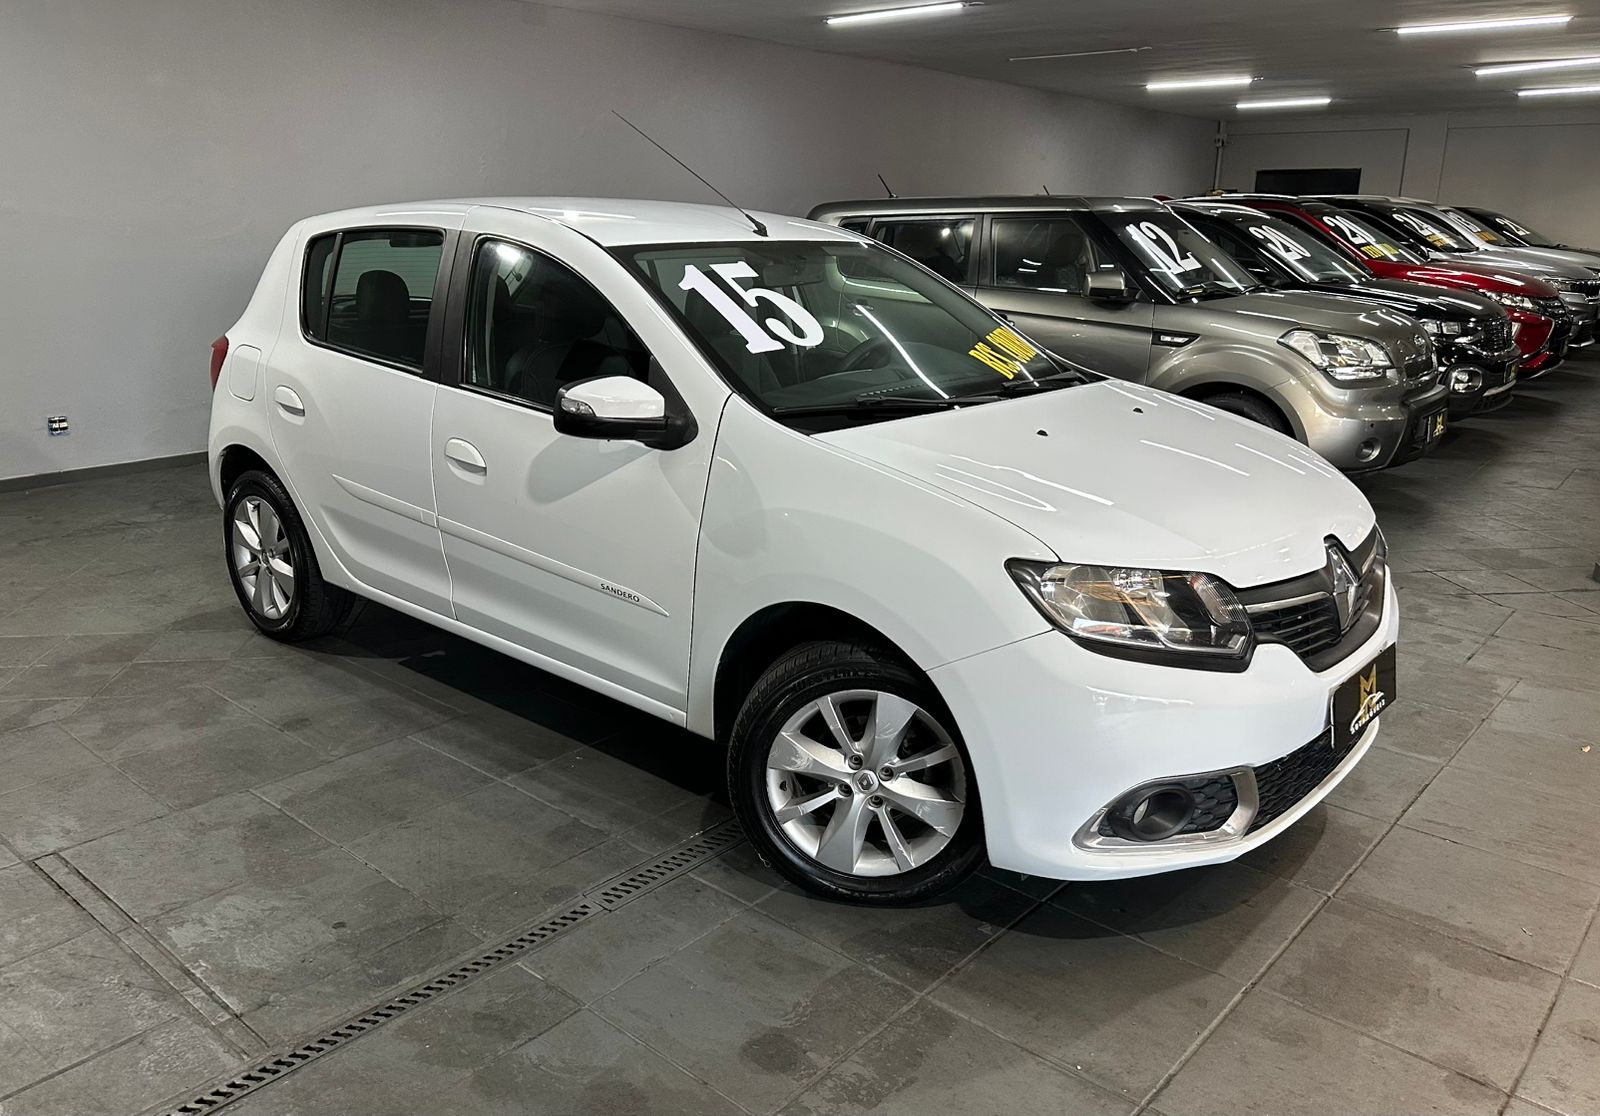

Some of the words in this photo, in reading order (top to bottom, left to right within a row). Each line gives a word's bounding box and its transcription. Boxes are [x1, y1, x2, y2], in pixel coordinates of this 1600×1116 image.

[1249, 225, 1312, 258] 20
[1322, 215, 1376, 245] 20
[1125, 221, 1202, 275] 12
[678, 261, 824, 355] 15
[600, 583, 640, 603] SANDERO
